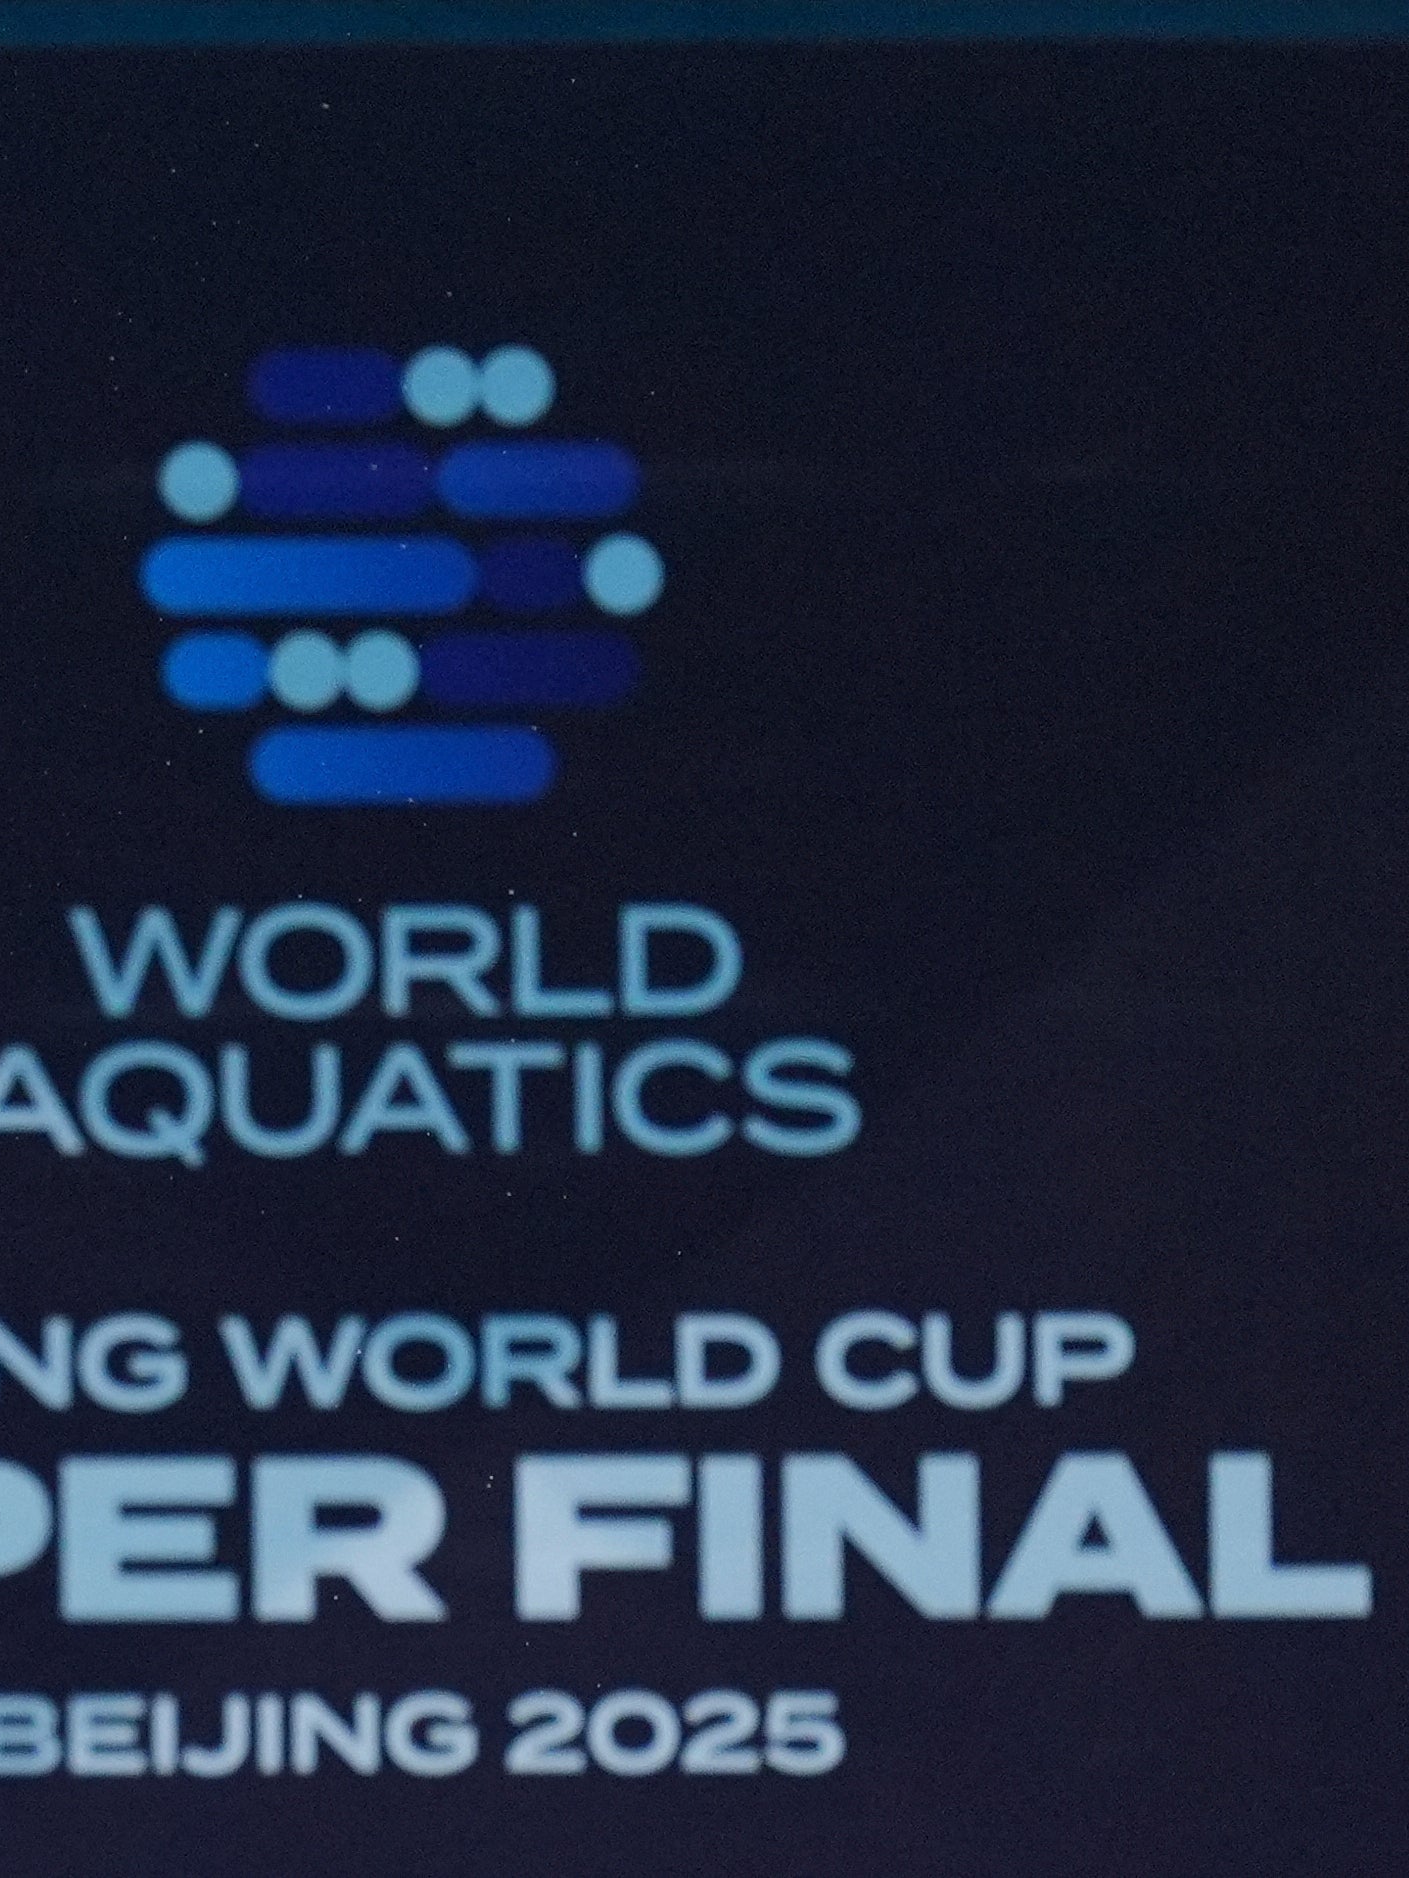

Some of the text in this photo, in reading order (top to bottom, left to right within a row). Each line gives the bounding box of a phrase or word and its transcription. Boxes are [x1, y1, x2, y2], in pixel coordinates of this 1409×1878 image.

[69, 903, 743, 1019] WORLD
[220, 1312, 781, 1411] WORLD
[816, 1310, 1135, 1410] CUP
[514, 1451, 1373, 1621] FINAL
[505, 1689, 846, 1776] 2025
